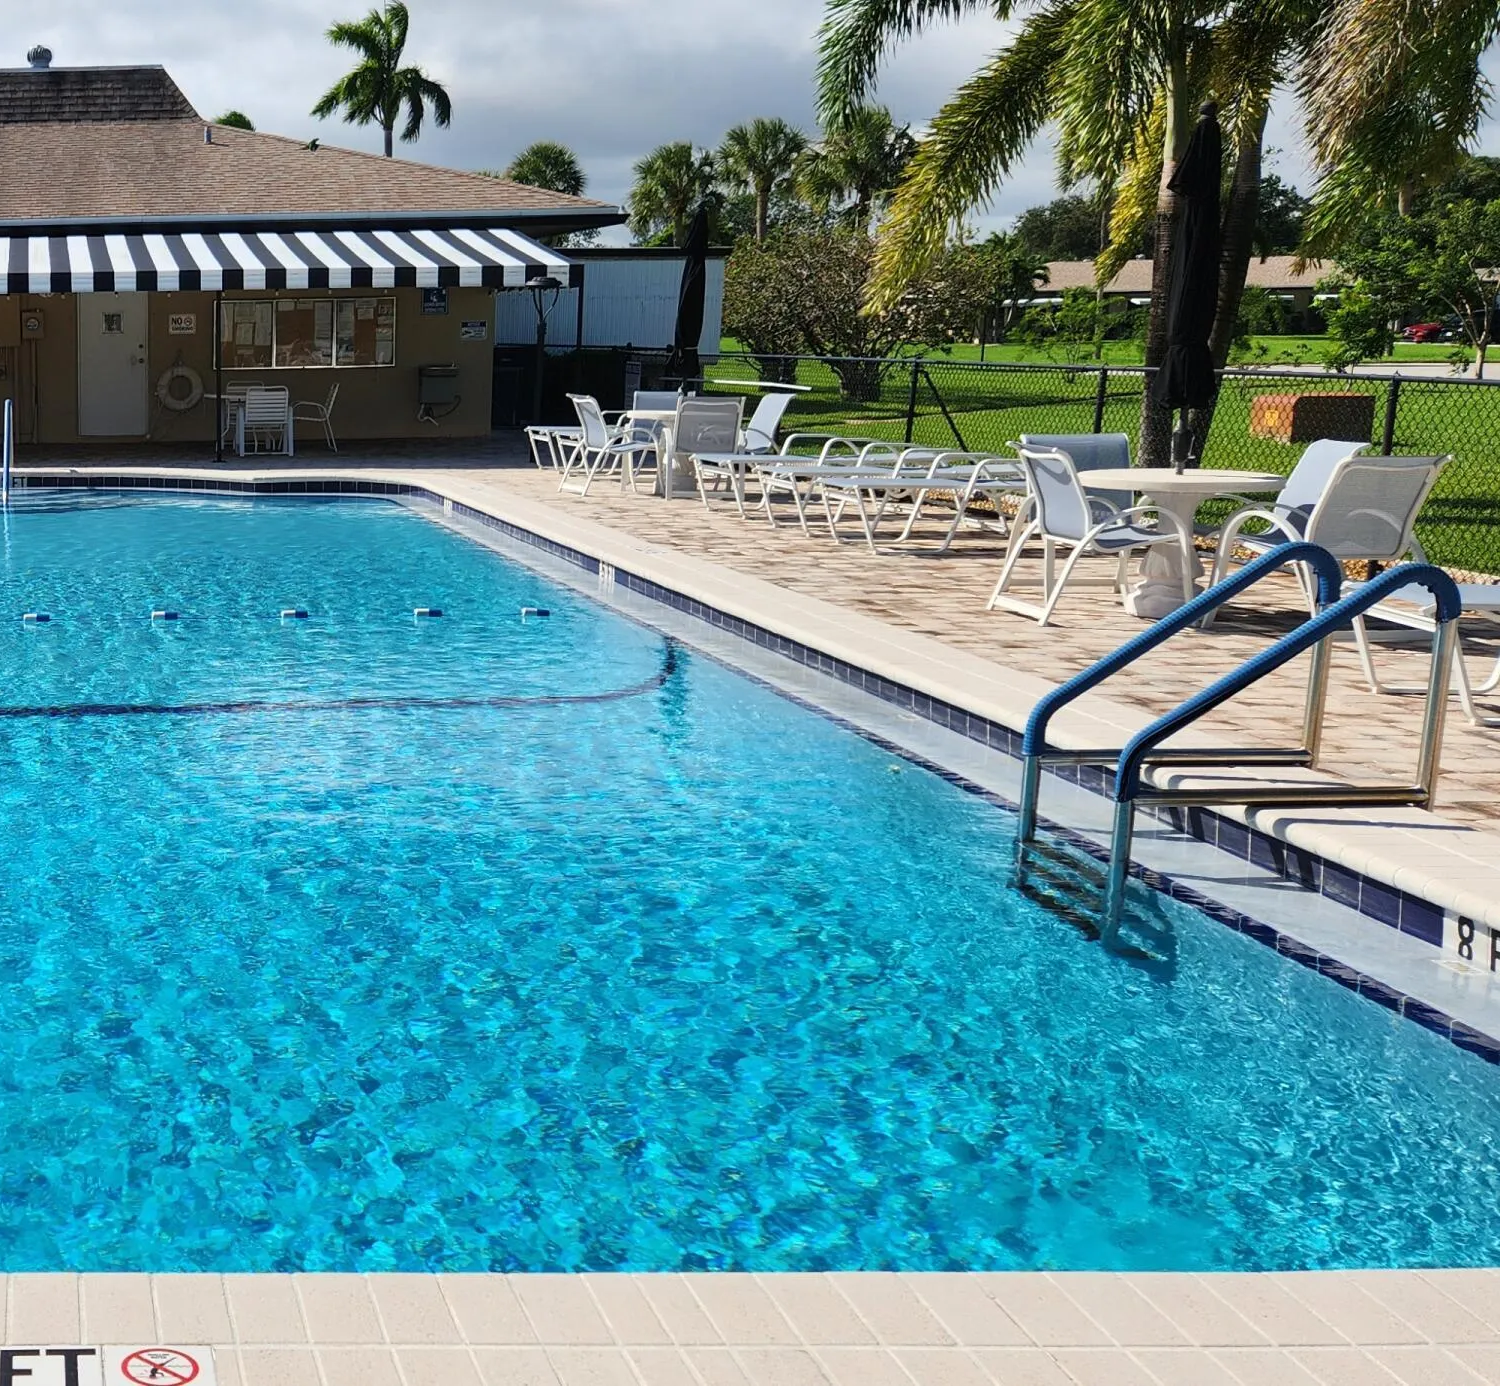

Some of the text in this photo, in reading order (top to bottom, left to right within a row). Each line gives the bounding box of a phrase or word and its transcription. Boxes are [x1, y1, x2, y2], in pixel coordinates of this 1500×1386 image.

[171, 317, 183, 325] NO
[1457, 914, 1475, 961] 8
[0, 1348, 96, 1386] FT
